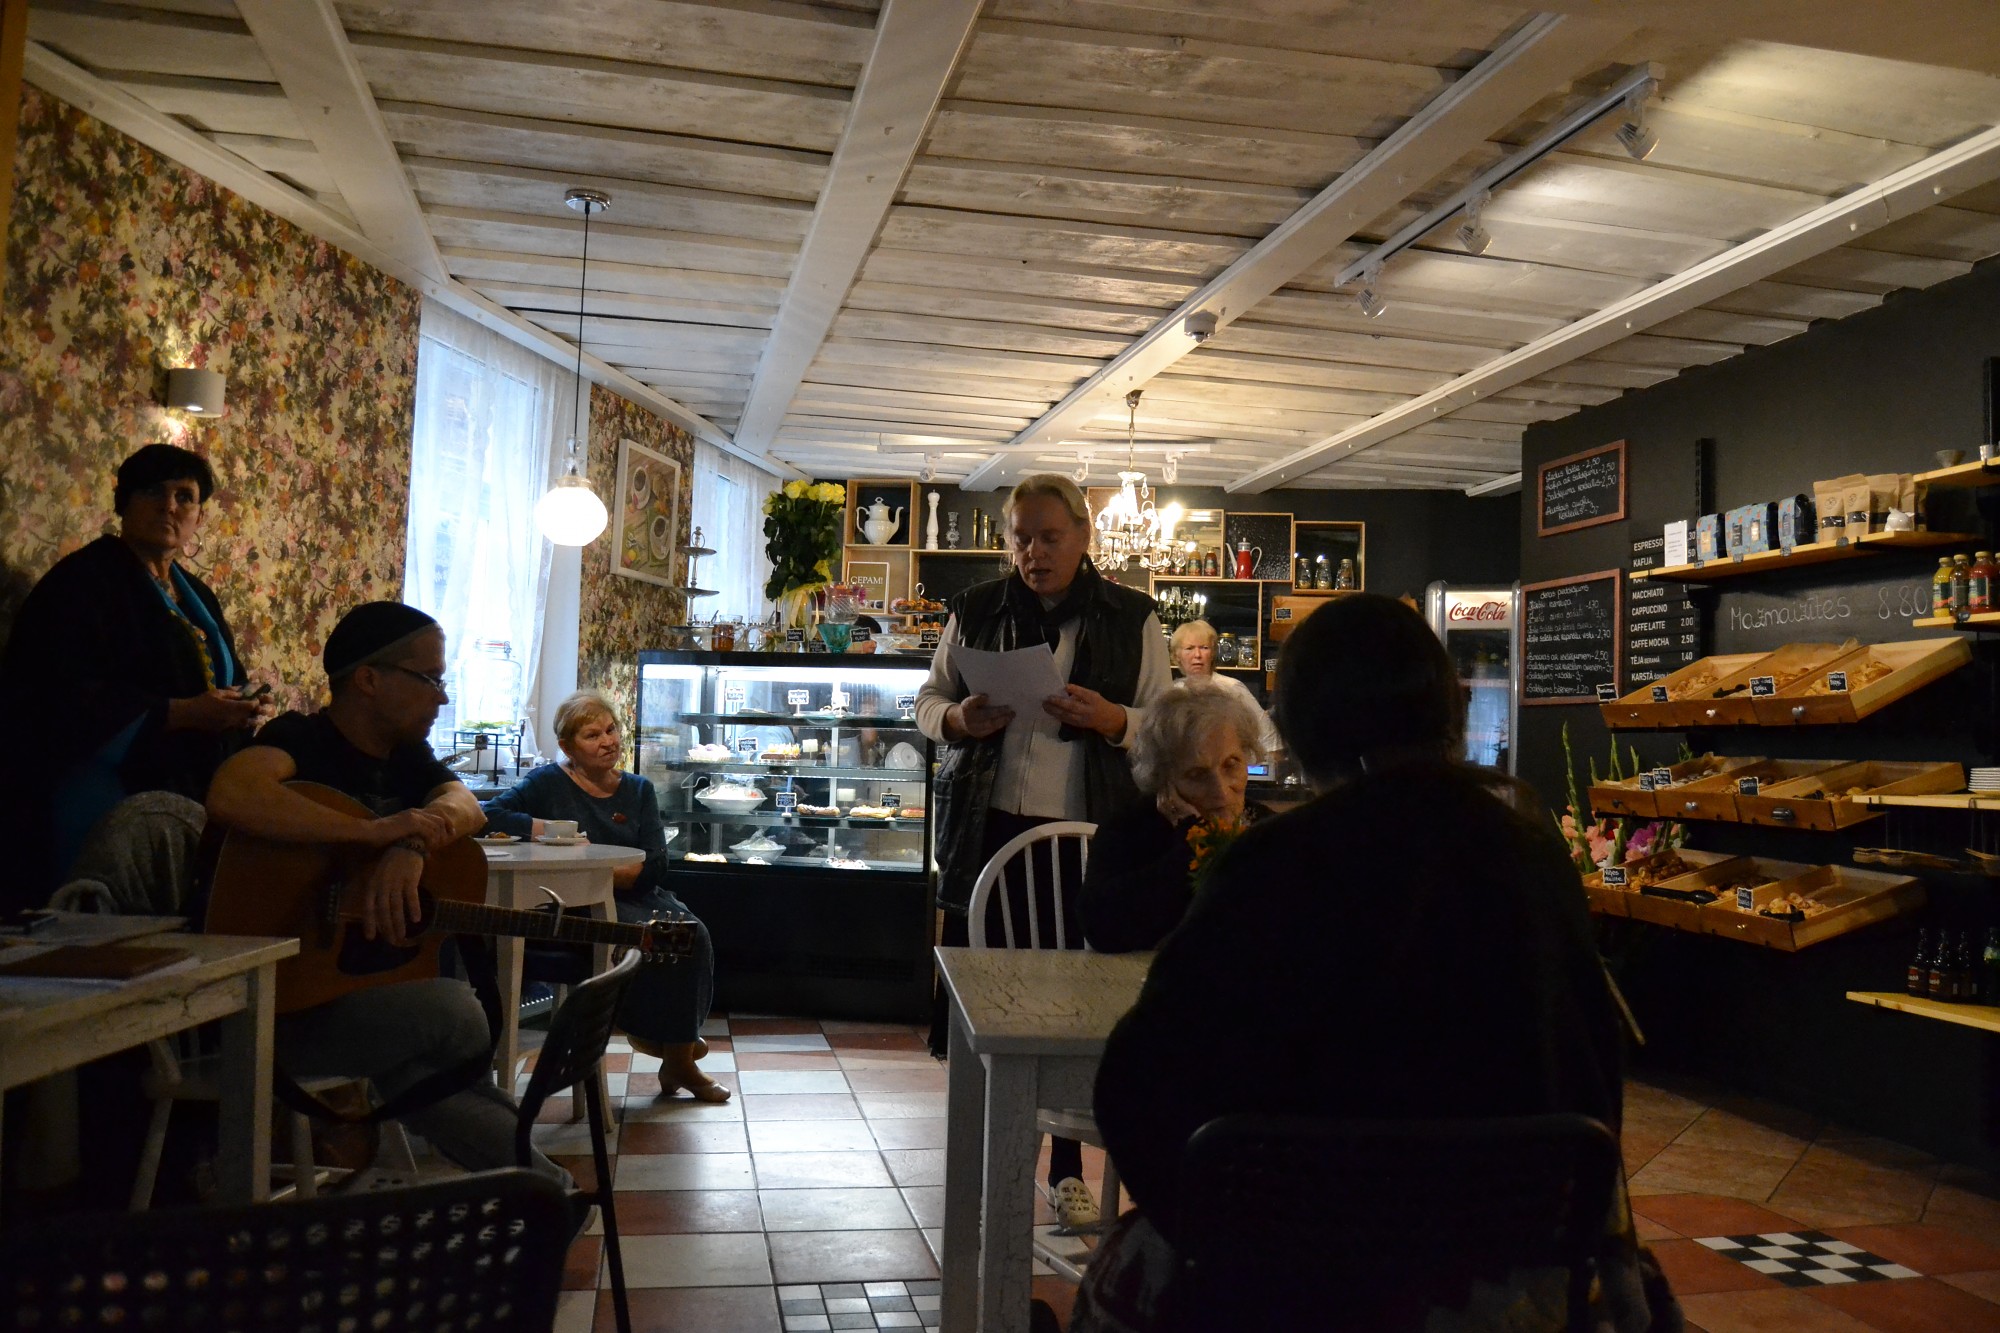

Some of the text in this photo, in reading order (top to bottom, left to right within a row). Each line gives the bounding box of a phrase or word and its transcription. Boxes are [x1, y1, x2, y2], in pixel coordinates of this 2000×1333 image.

[1634, 538, 1664, 551] ESPRESSO
[1633, 556, 1653, 568] KAFIJA
[1632, 587, 1664, 600] MACCHIATO
[1878, 585, 1928, 620] 8.80
[1631, 603, 1668, 616] CAPPUCCINO
[1630, 623, 1648, 633] CAFFE
[1648, 620, 1666, 631] LATTE
[1630, 640, 1648, 649] CAFFE
[1648, 637, 1670, 648] MOCHA
[1631, 669, 1654, 681] KARSTĀ
